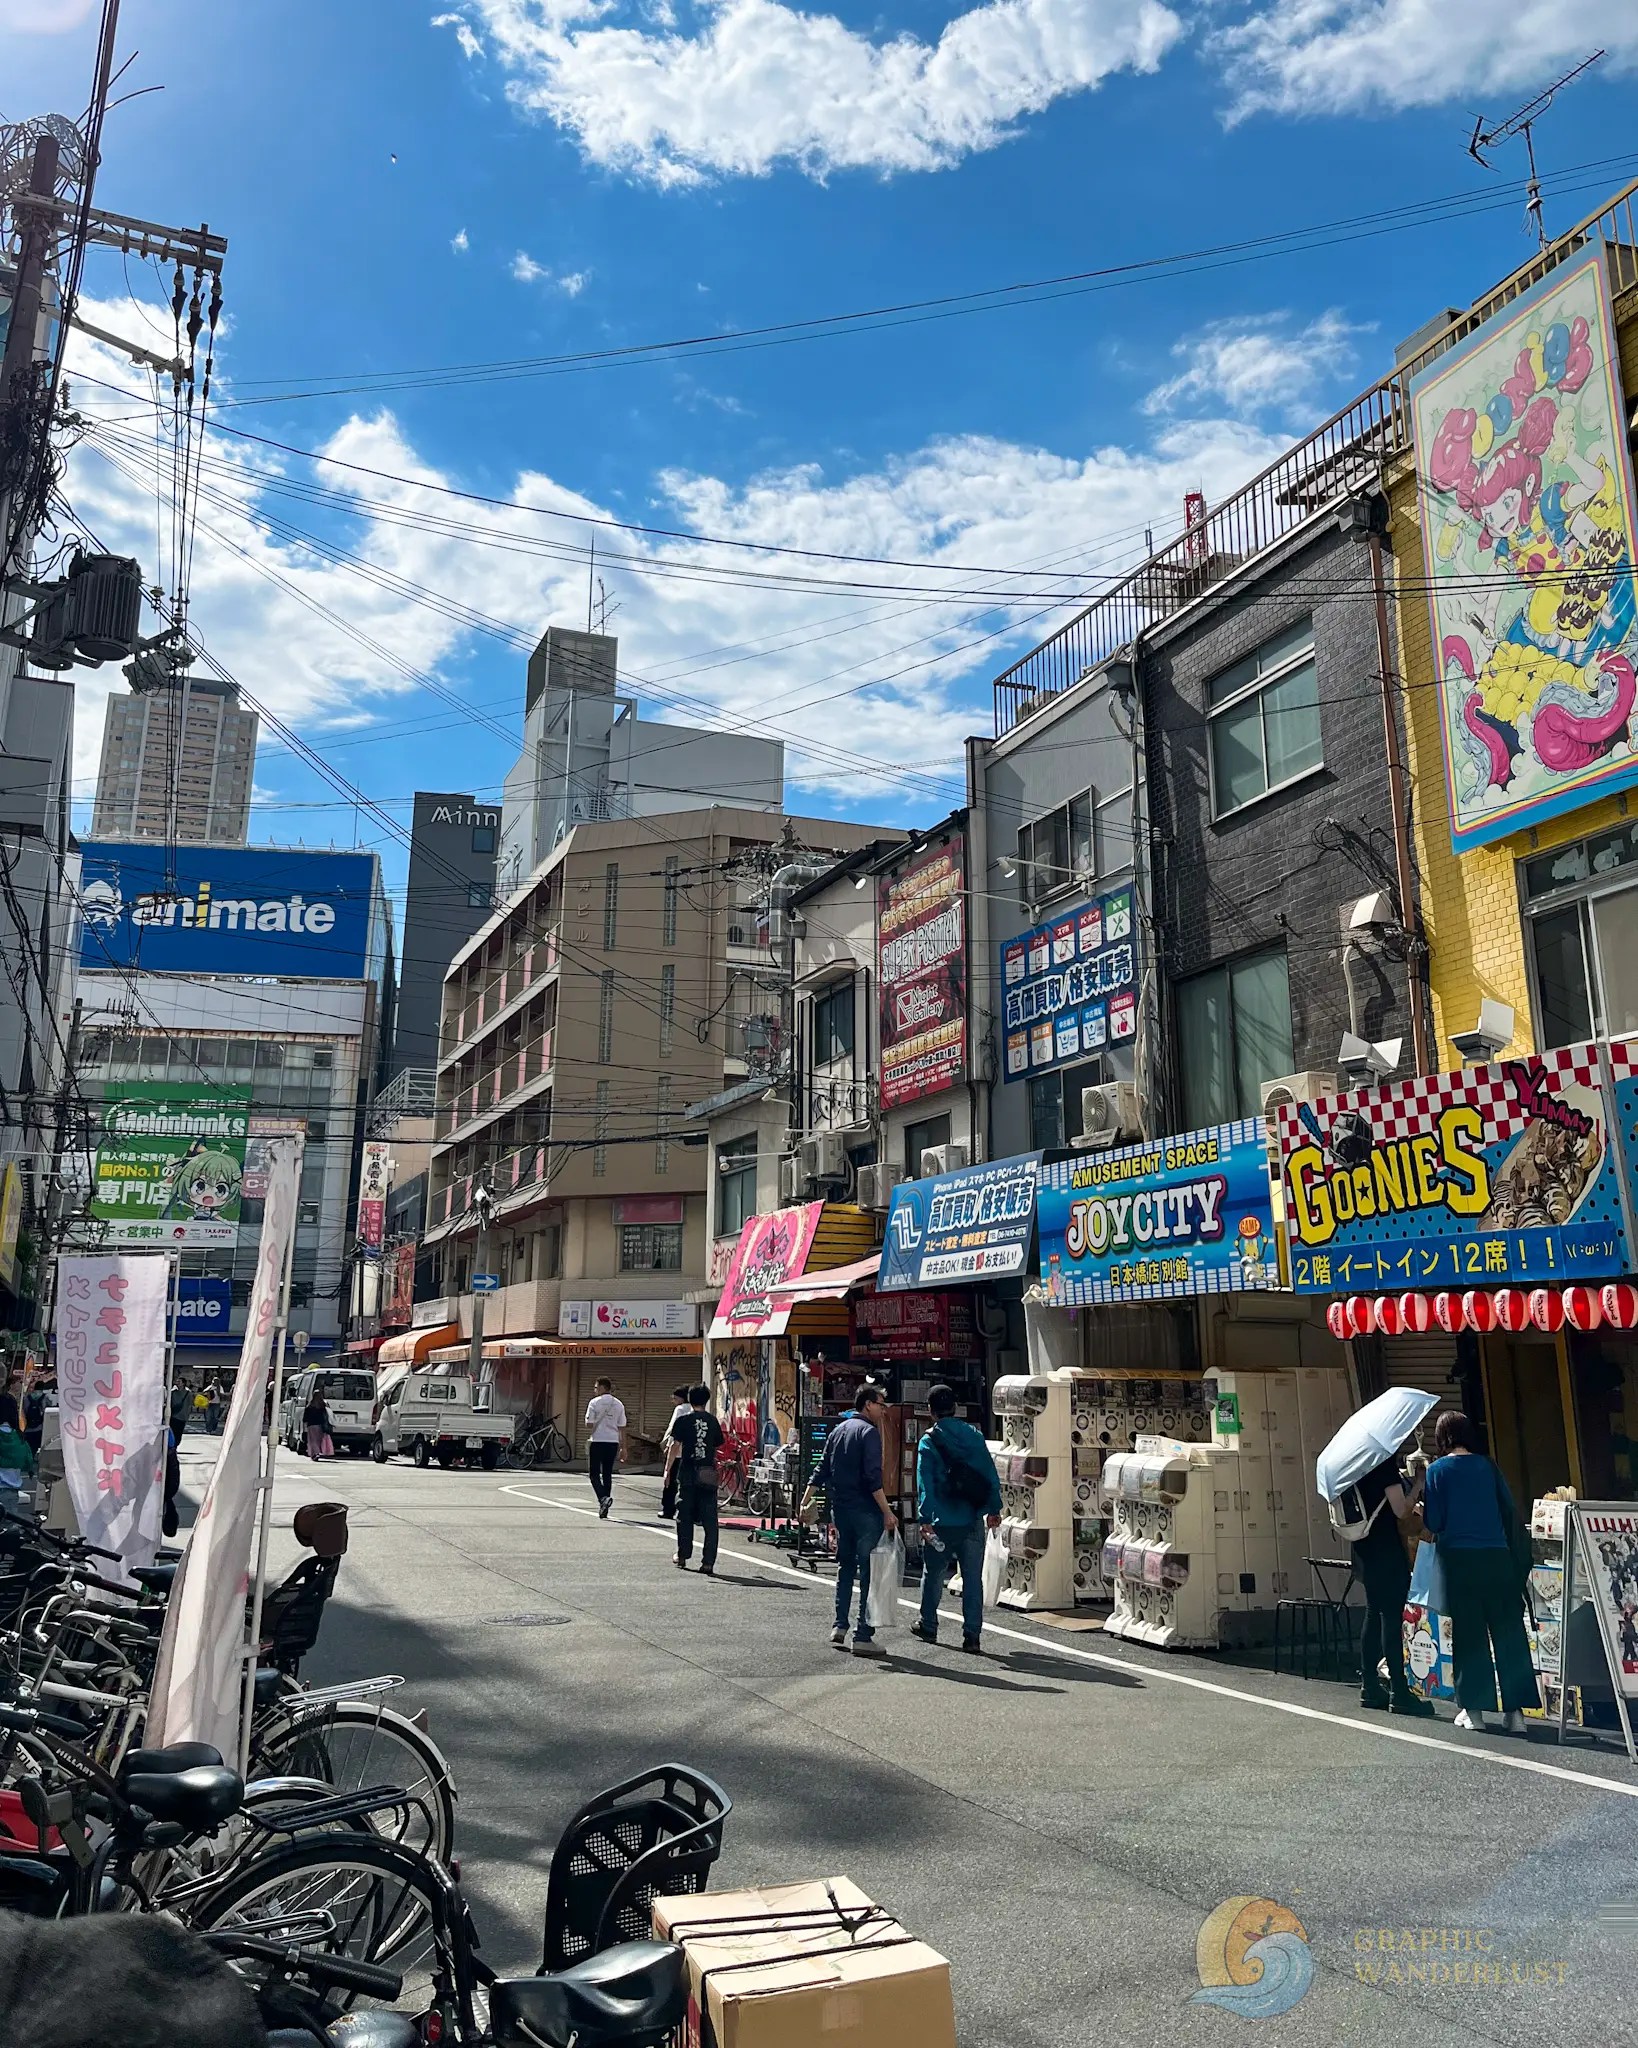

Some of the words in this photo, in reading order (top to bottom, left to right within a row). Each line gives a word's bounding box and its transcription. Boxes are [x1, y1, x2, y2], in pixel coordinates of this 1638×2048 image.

[132, 881, 335, 934] animate
[882, 929, 915, 986] SUPER
[915, 905, 961, 969] POSITION
[911, 984, 938, 1003] Night
[912, 998, 945, 1022] Gallery
[115, 1112, 247, 1138] Melonbooks
[99, 1163, 176, 1177] 国内No.1の
[1072, 1154, 1161, 1189] AMUSEMENT
[1166, 1140, 1218, 1170] SPACE
[968, 1175, 984, 1186] スマホ
[986, 1171, 996, 1182] PC
[97, 1180, 174, 1206] 専門店
[1067, 1179, 1223, 1252] JOYCITY
[1110, 1257, 1189, 1287] 日本橋店別館
[1296, 1255, 1332, 1286] 2階
[1337, 1248, 1440, 1283] イートイン
[612, 1316, 658, 1329] SAKURA
